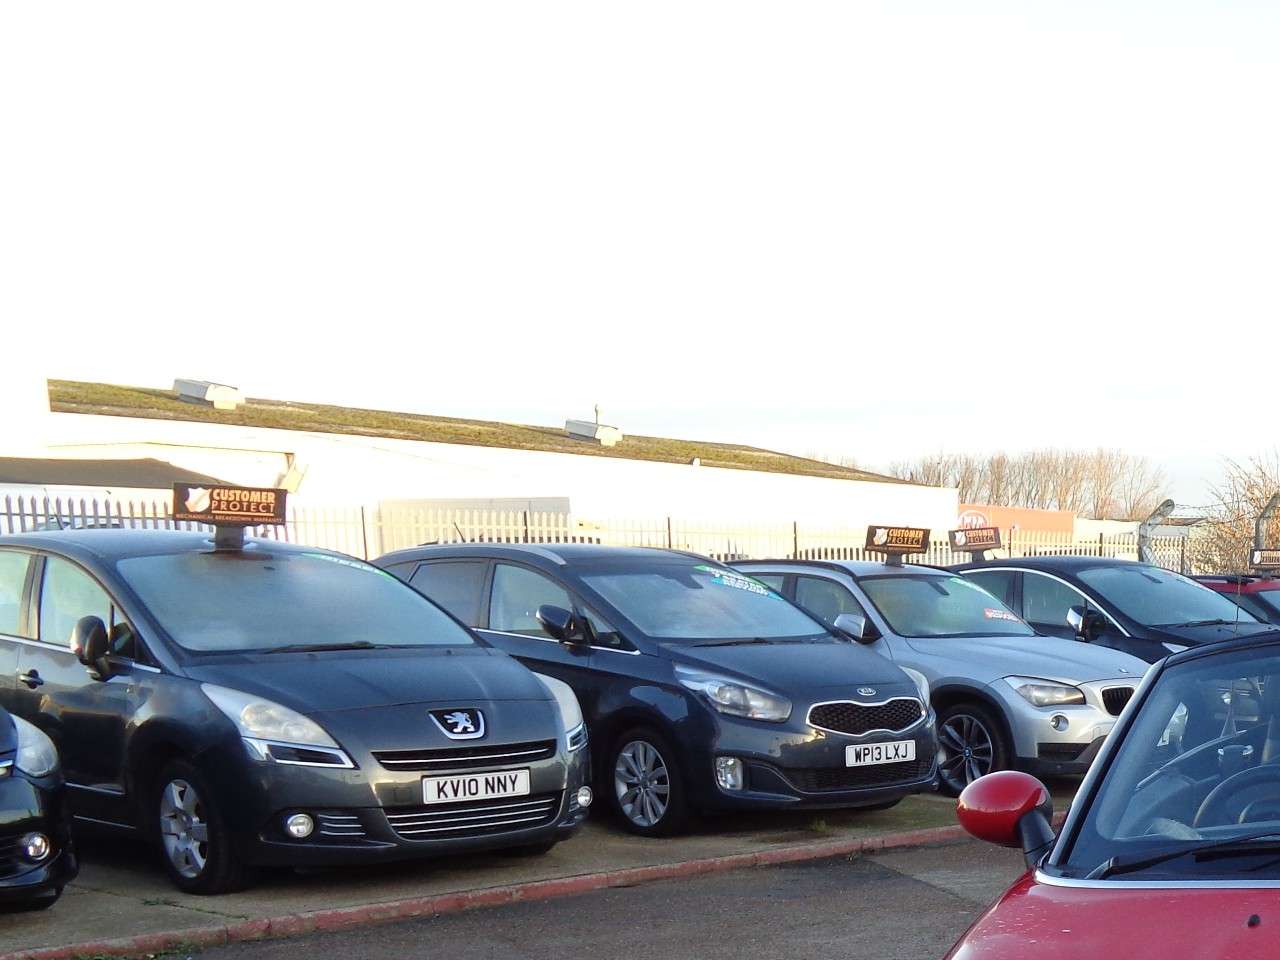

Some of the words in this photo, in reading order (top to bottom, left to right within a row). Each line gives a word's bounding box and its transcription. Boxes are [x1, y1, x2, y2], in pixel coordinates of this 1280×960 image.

[213, 489, 275, 503] CUSTOMER
[212, 501, 275, 513] PROTECT
[889, 529, 923, 539] CUSTOMER
[887, 537, 922, 545] PROTECT
[854, 747, 882, 763] WP13
[885, 743, 908, 760] LXJ
[437, 778, 479, 799] KV10
[485, 773, 518, 794] NNY
